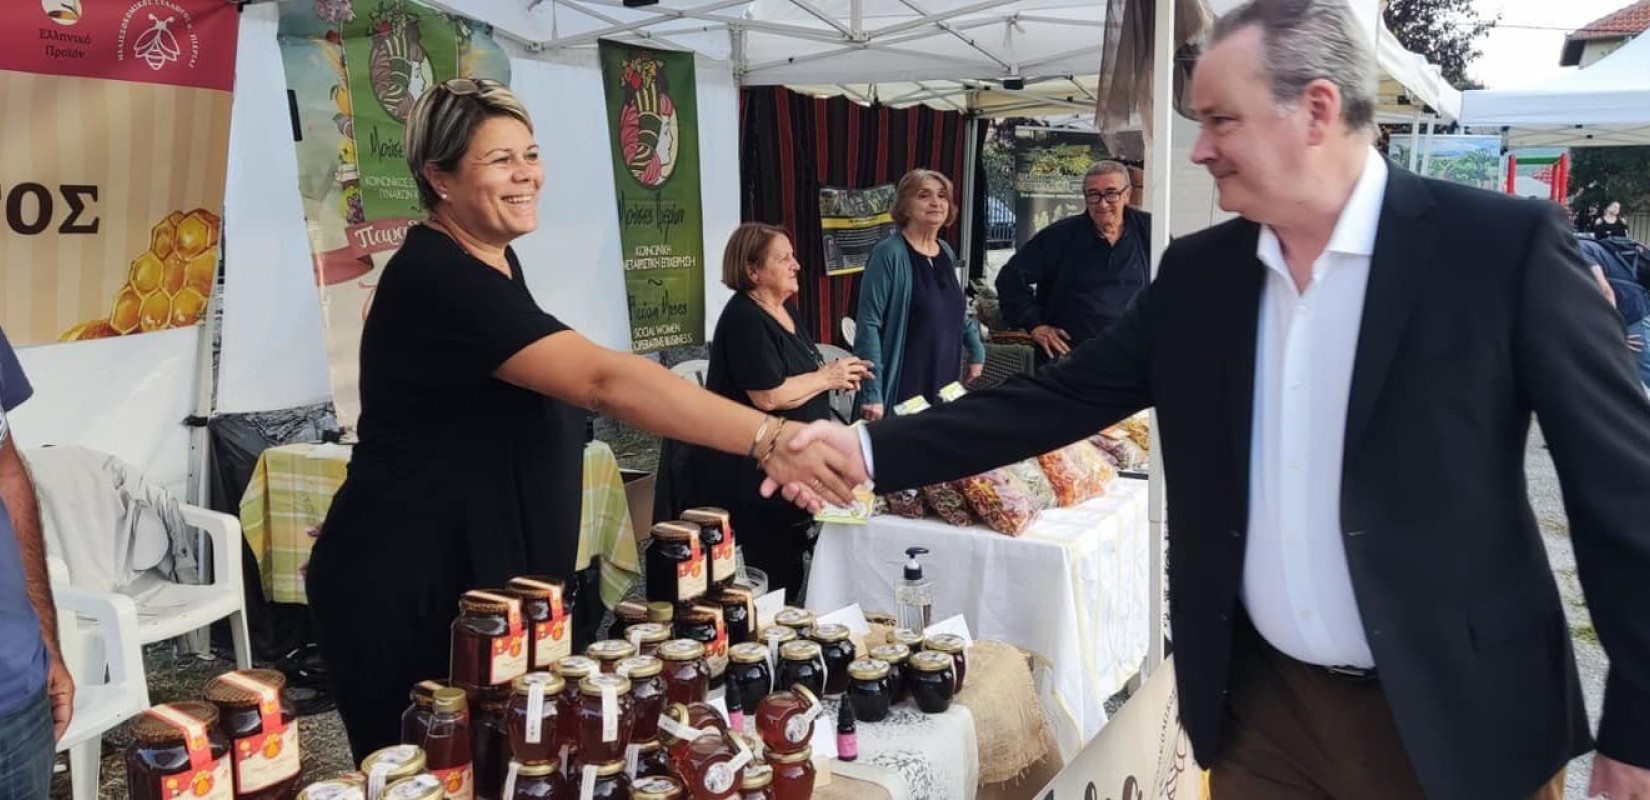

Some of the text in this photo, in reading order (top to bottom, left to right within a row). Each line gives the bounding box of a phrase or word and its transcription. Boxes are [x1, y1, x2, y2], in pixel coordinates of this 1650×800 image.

[39, 28, 92, 45] Ελληνικό
[0, 182, 100, 236] ΟΣ
[634, 322, 680, 339] SOCIAL WOMEN
